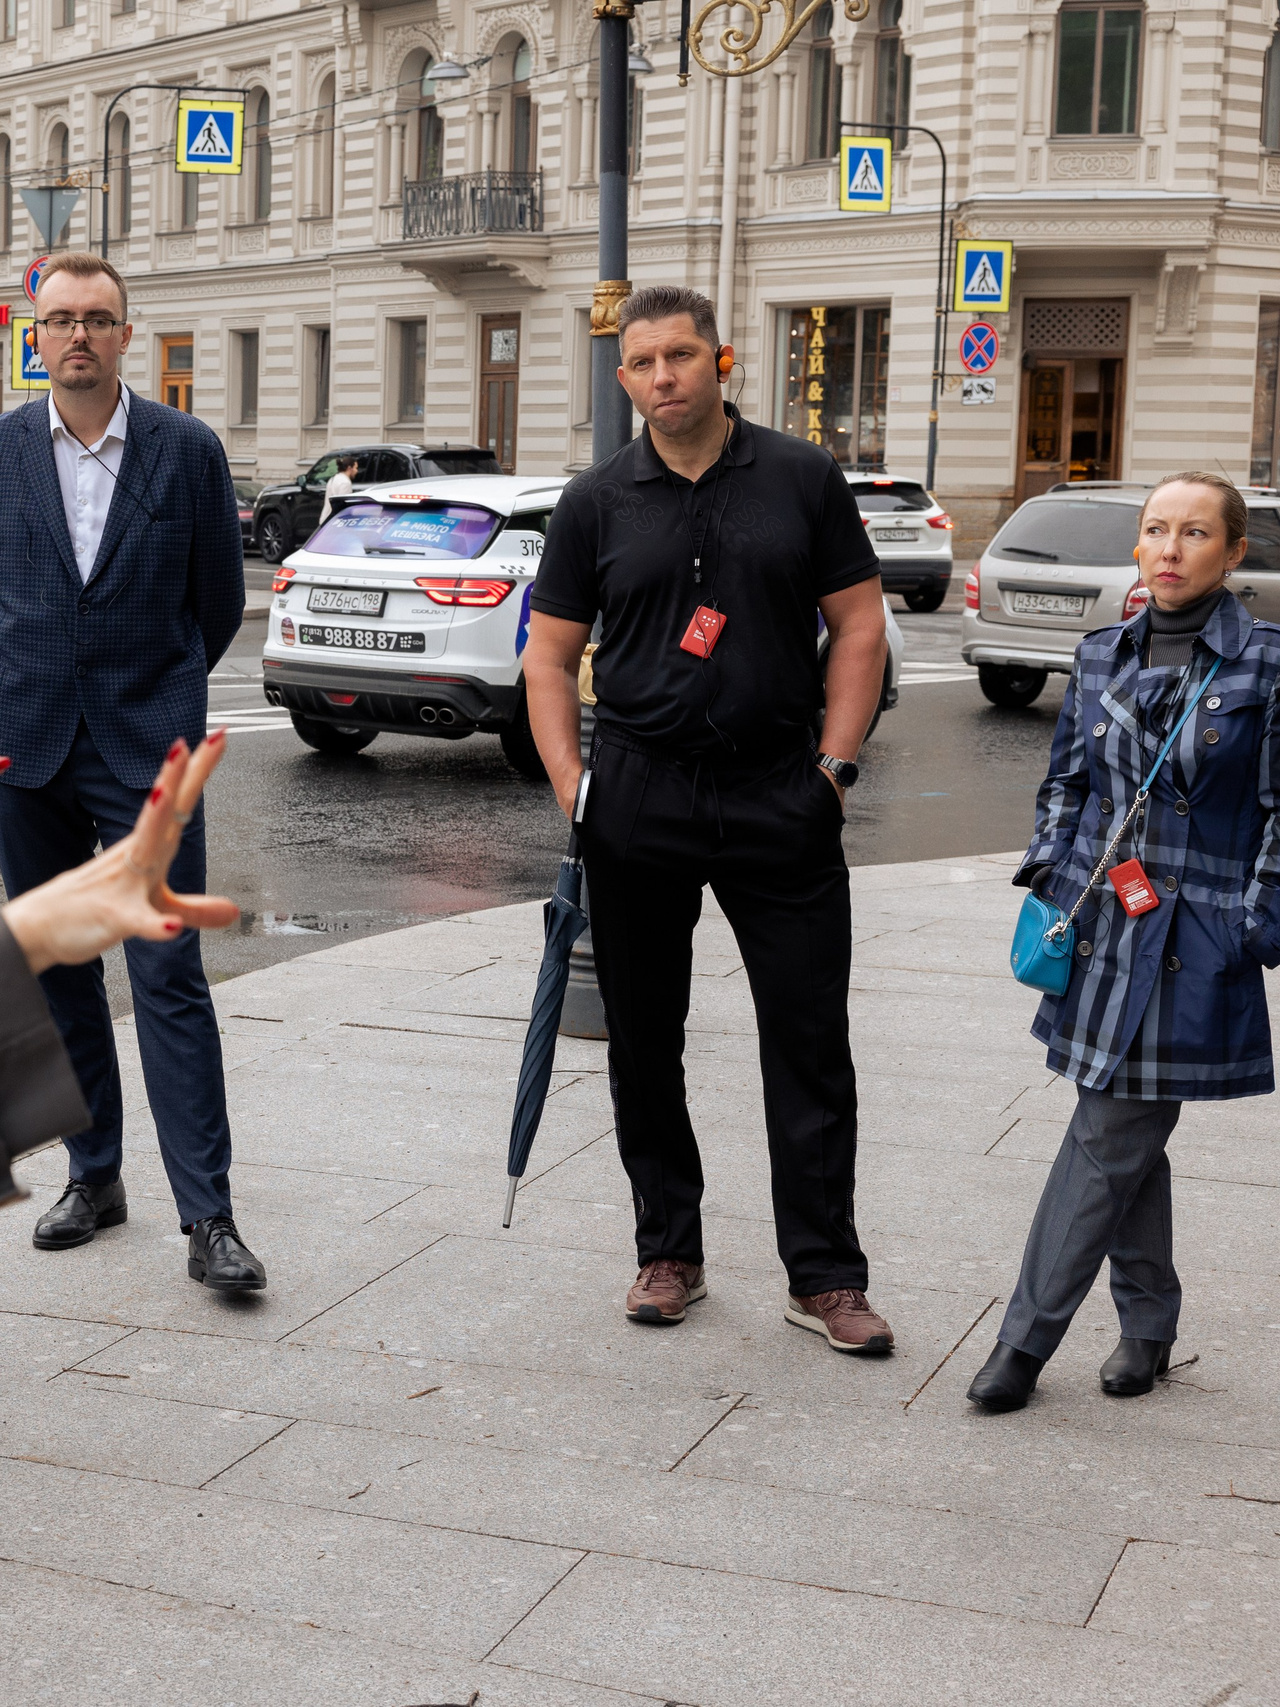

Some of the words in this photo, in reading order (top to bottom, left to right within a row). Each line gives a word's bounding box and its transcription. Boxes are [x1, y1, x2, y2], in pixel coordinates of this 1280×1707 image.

[809, 306, 826, 375] ЧАЙ
[567, 469, 664, 534] BOSS
[410, 522, 450, 534] МНОГО
[390, 529, 441, 543] КЕШБЭКА
[1023, 567, 1074, 577] LADA
[309, 575, 386, 585] GEELY
[362, 593, 380, 606] 198
[1063, 597, 1081, 608] 198
